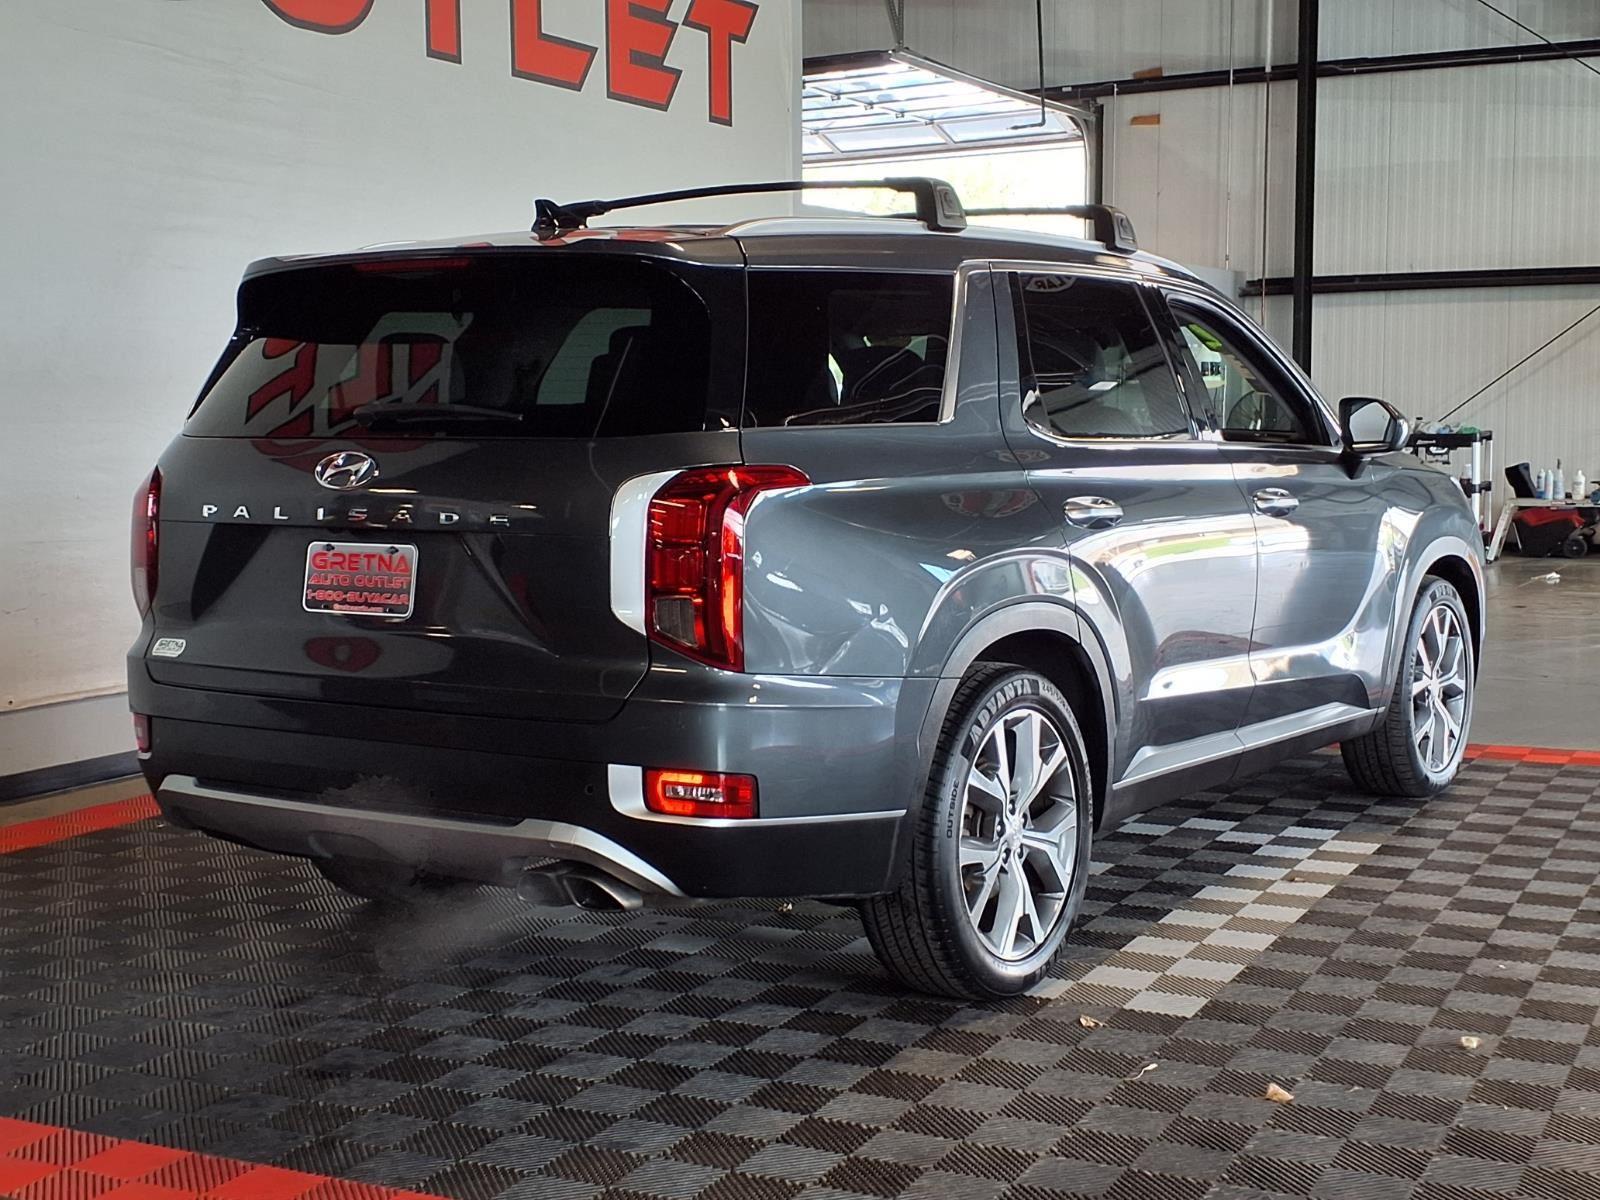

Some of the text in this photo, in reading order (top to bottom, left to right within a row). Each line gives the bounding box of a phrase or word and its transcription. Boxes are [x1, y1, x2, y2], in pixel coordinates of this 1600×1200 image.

[202, 504, 510, 527] PALISADE
[311, 552, 410, 573] GRETNA
[308, 573, 411, 590] AUTO OUTLET
[307, 588, 409, 606] 1-800-BUYACAR
[970, 678, 1032, 745] ADVANTA
[946, 779, 960, 839] OUTSIDE
